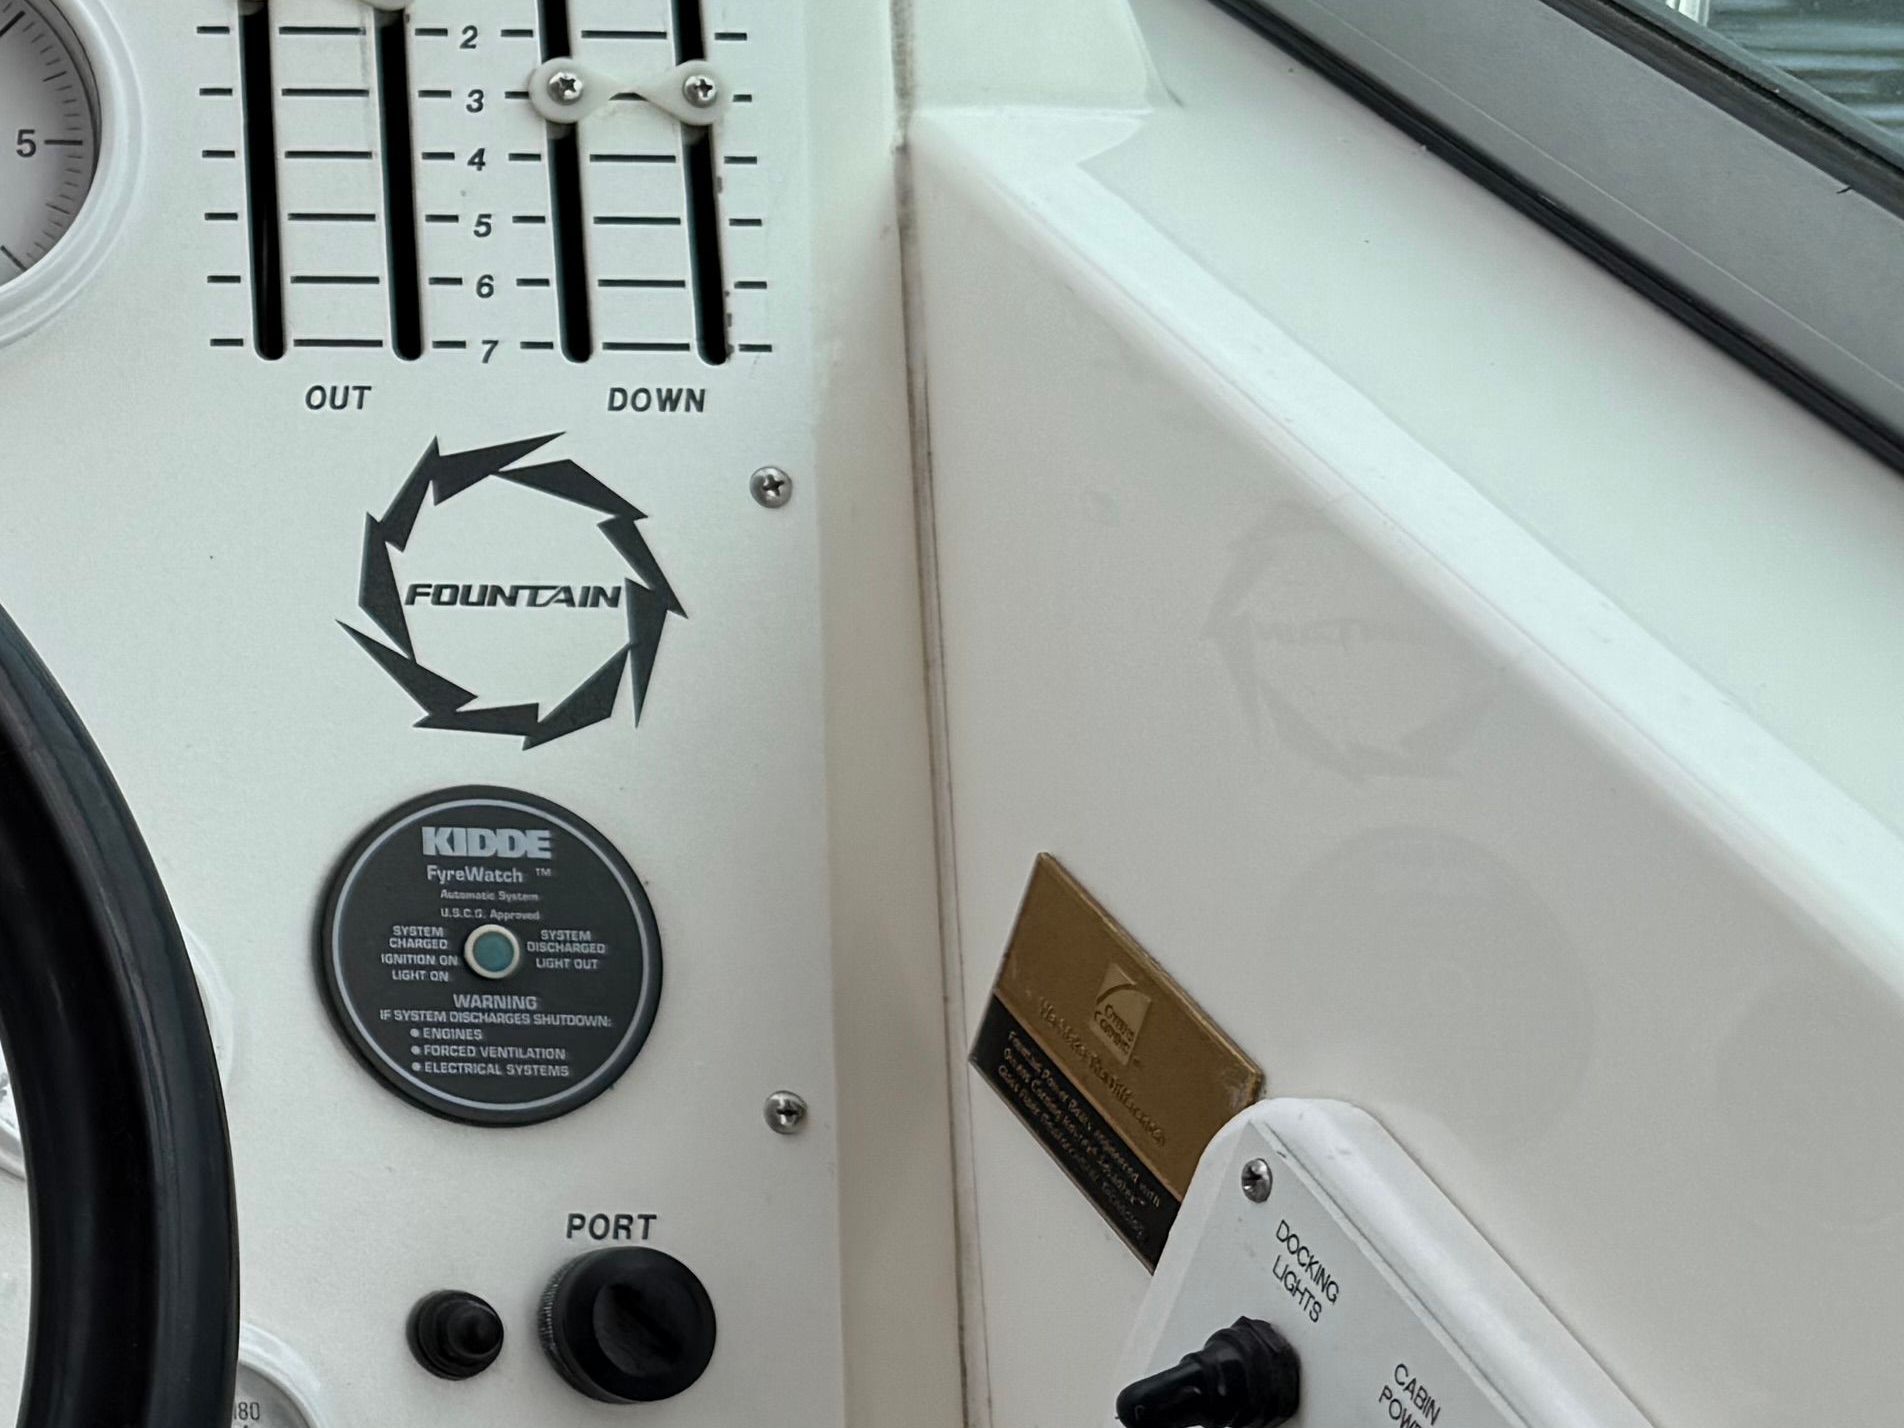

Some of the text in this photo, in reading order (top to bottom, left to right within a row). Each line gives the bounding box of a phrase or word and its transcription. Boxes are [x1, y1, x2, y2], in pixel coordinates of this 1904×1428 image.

[305, 385, 373, 412] OUT
[607, 387, 707, 414] DOWN
[405, 582, 622, 609] FOUNTAIN
[421, 826, 553, 860] KIDDE
[426, 864, 524, 885] FyreWatch
[440, 888, 540, 903] Automatic System
[490, 909, 541, 922] Approved
[392, 924, 444, 938] SYSTEM
[540, 928, 592, 942] SYSTEM
[389, 936, 449, 950] CHARGED
[527, 940, 606, 954] DISCHARGED
[381, 953, 458, 967] IGNITION ON
[536, 957, 599, 970] LIGHT OUT
[392, 969, 449, 982] LIGHT ON
[453, 993, 537, 1010] WARNING
[379, 1009, 613, 1028] IF SYSTEM DISCHARGES SHUTDOWN:
[422, 1028, 483, 1041] ENGINES
[423, 1044, 567, 1061] FORCED VENTILATION
[424, 1062, 570, 1078] ELECTRICAL SYSTEMS
[566, 1213, 659, 1241] PORT
[1276, 1219, 1341, 1305] DOCKING
[1272, 1255, 1323, 1323] LIGHTS
[1393, 1363, 1443, 1427] CABIN
